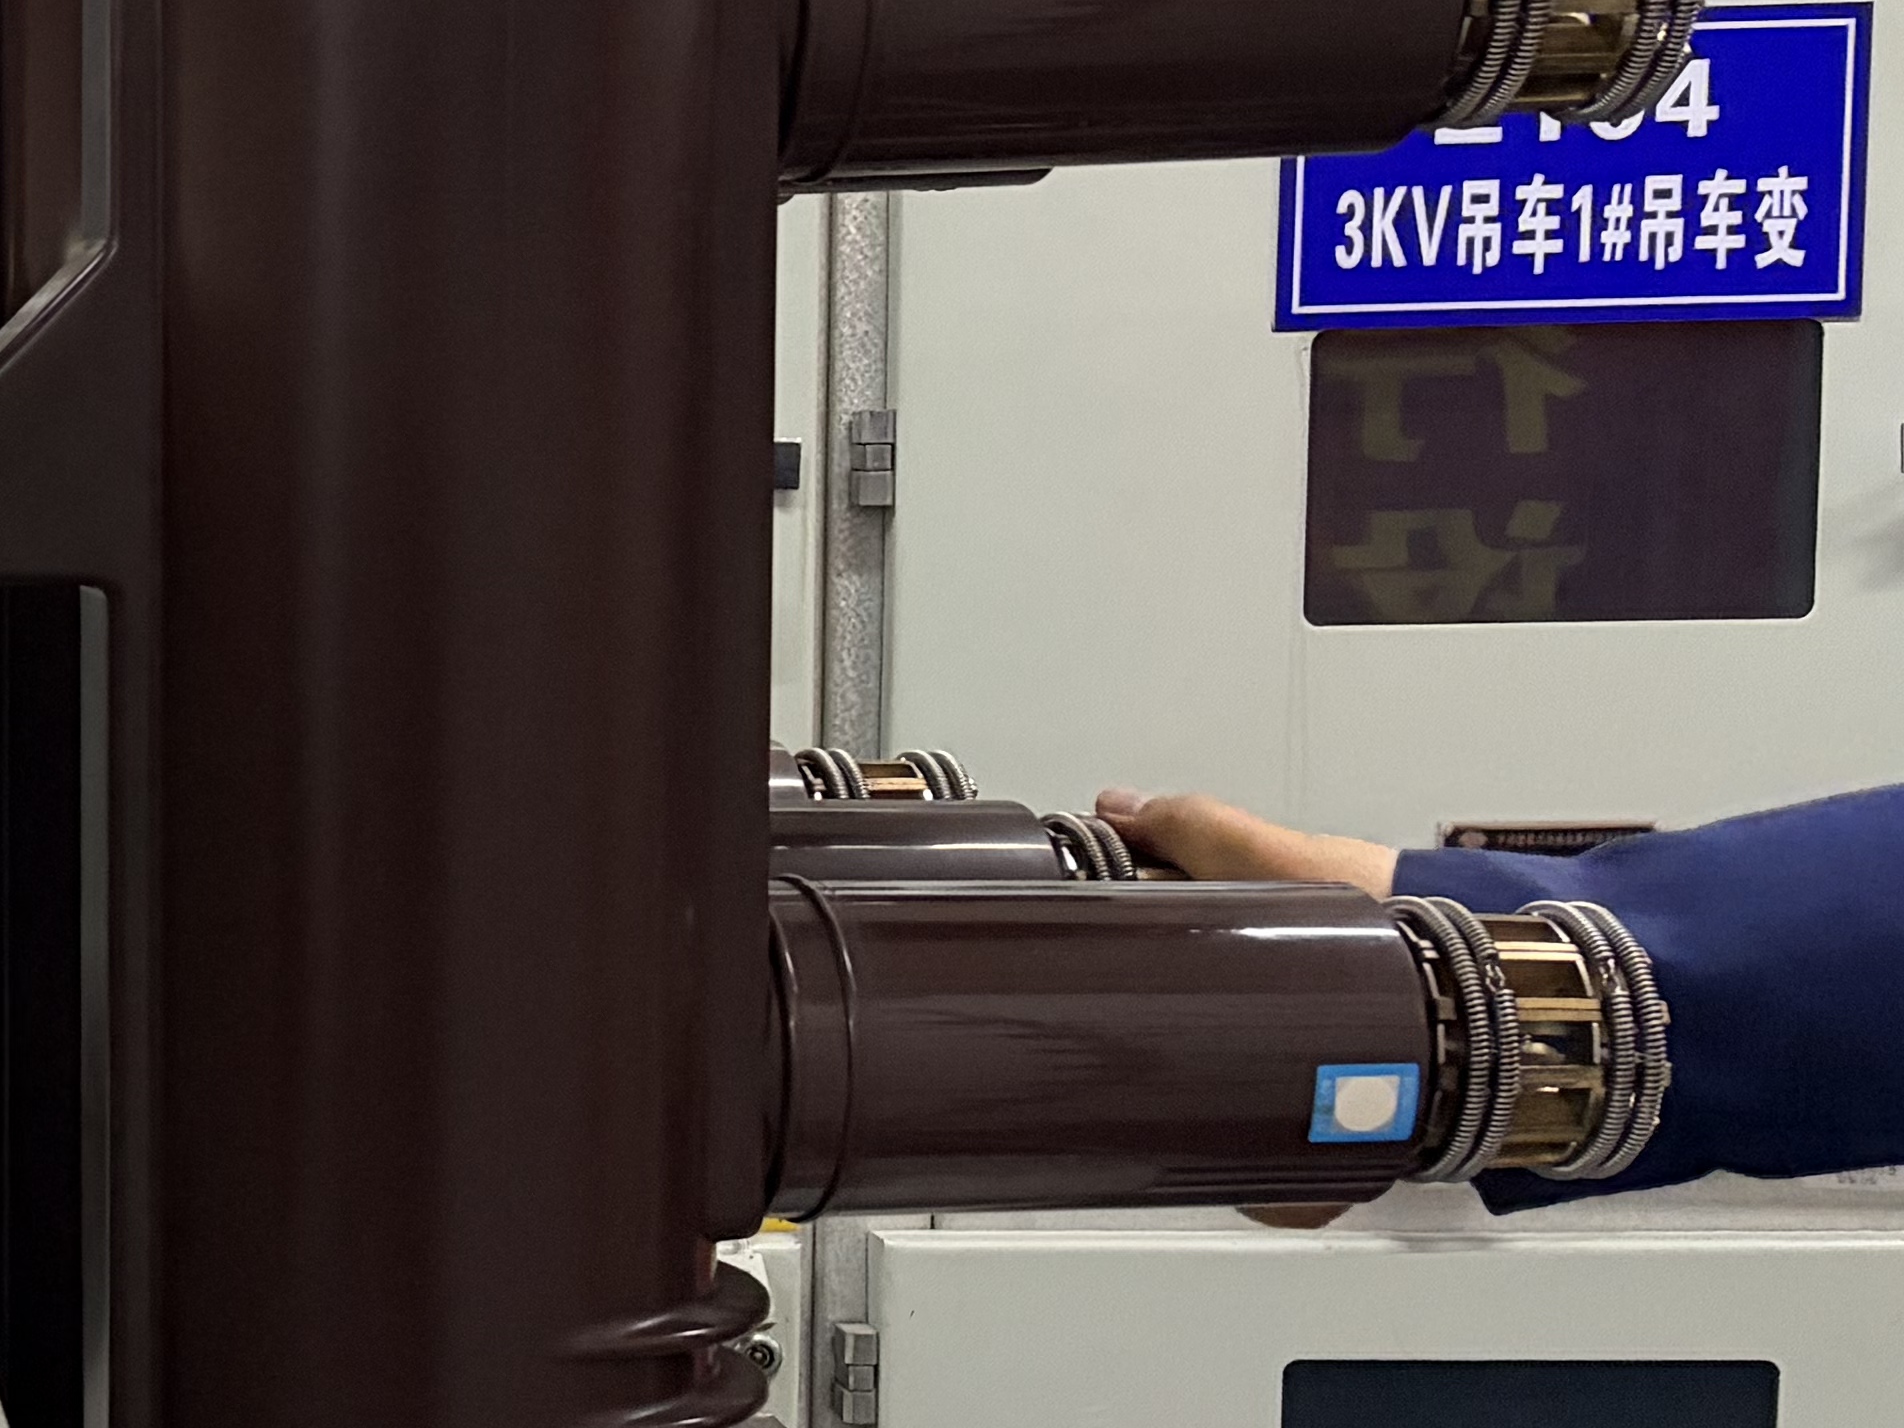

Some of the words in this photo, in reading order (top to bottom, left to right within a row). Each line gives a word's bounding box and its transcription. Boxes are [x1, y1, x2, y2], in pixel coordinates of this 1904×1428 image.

[1333, 164, 1810, 275] 3KV吊车1#吊车变
